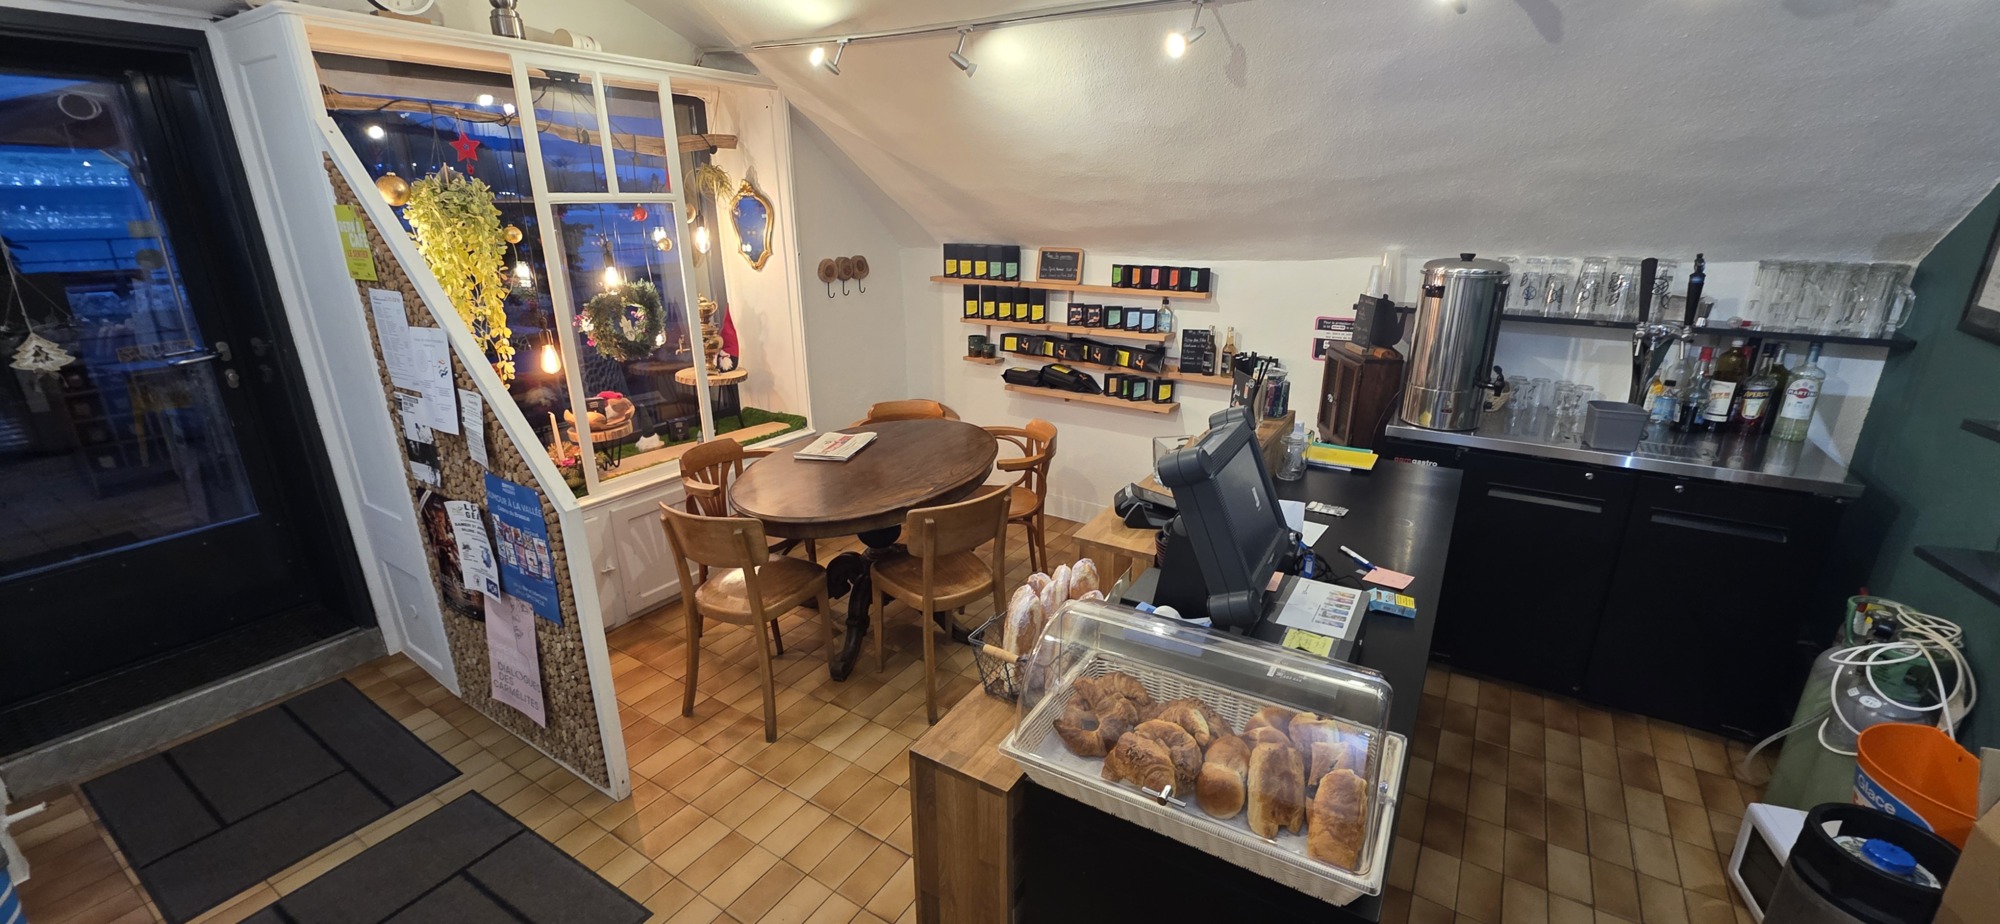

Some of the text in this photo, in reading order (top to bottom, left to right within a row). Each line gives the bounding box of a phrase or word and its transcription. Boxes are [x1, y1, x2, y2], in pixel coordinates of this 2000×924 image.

[1788, 389, 1817, 397] MARTINI
[497, 661, 541, 693] DIALOGUES
[498, 672, 514, 686] DES
[493, 679, 539, 711] CARMÉLITES
[1857, 774, 1896, 815] Glace
